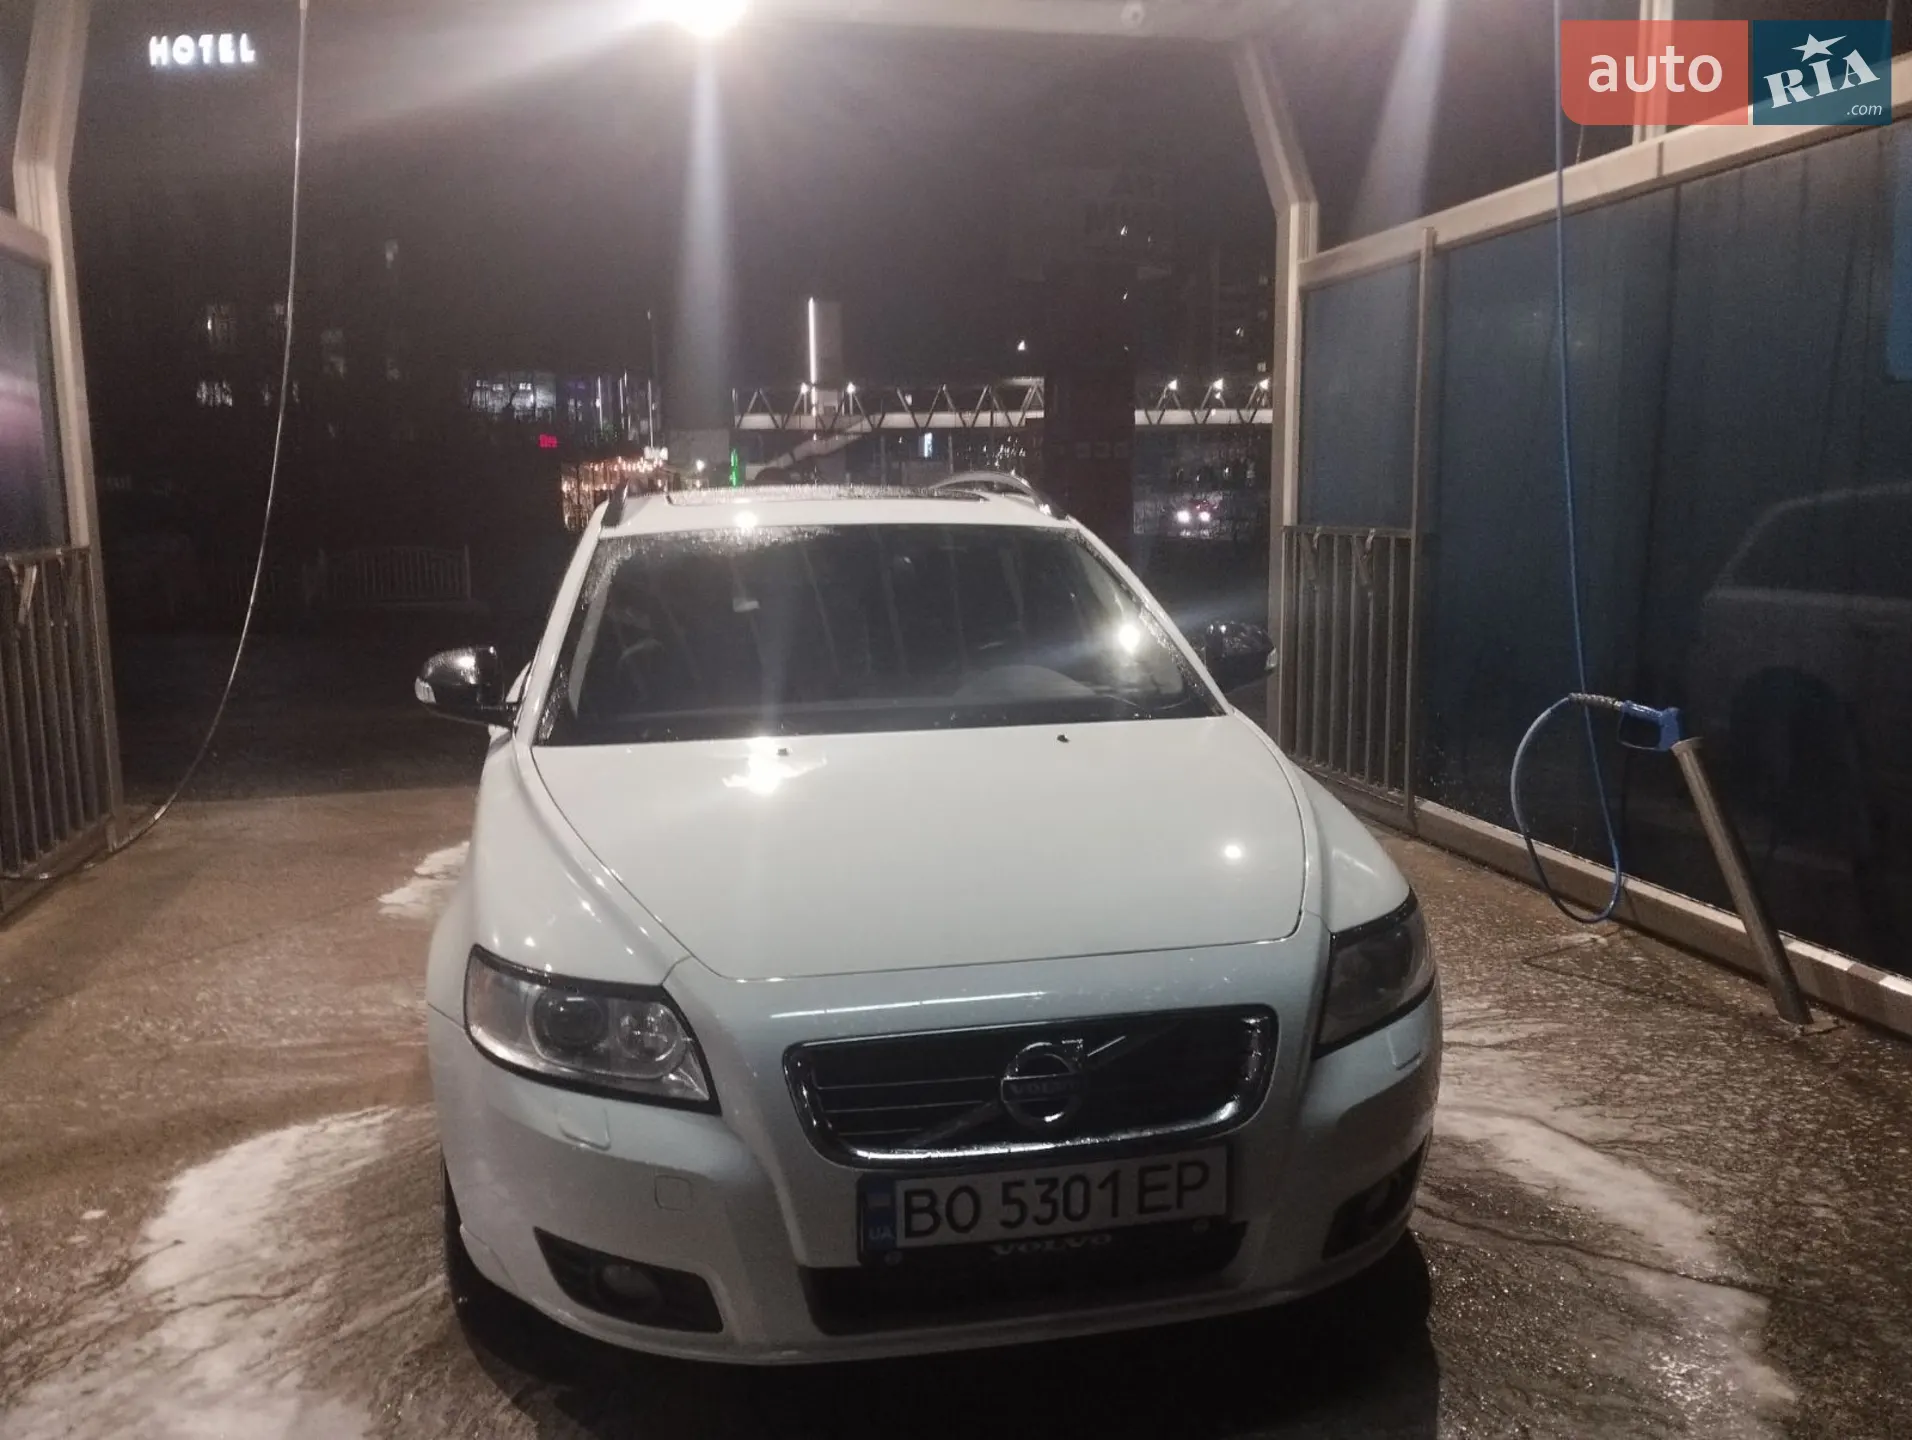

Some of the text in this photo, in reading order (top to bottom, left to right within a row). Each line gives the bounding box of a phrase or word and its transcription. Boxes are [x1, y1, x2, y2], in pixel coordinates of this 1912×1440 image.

[148, 33, 256, 66] HOTEL
[903, 1159, 1210, 1239] BO 5301 EP
[867, 1225, 896, 1241] UA
